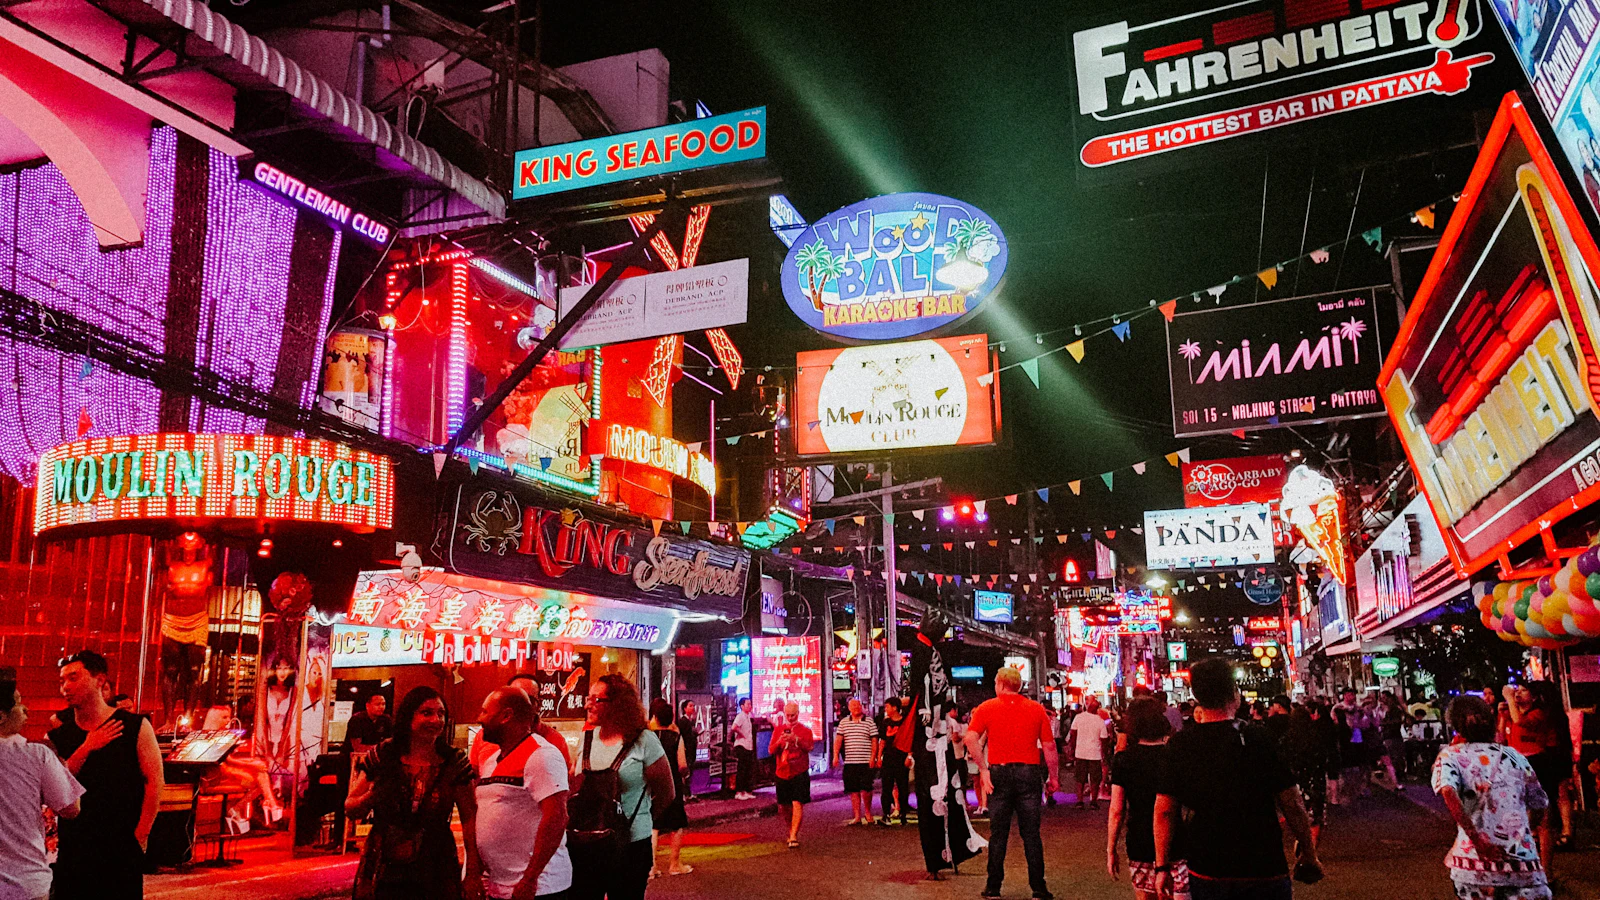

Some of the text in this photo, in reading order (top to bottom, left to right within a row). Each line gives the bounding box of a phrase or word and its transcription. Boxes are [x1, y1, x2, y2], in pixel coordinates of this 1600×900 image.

[1073, 1, 1429, 115] FAHRENHEIT
[1108, 71, 1442, 156] THE HOTTEST BAR IN PATTAYA
[519, 120, 761, 187] KING SEAFOOD
[254, 162, 389, 243] GENTLEMAN CLUB
[836, 254, 958, 300] BALL
[823, 294, 967, 328] KARAOKE BAR
[826, 407, 893, 427] MULIN
[1183, 411, 1198, 424] SOI
[1204, 408, 1217, 422] 15
[1232, 401, 1275, 420] WALKING
[1280, 396, 1315, 413] STREET
[1331, 389, 1376, 408] PATTAYA
[52, 449, 375, 506] MOULIN ROUGE
[1211, 479, 1260, 491] AGO-GO
[1212, 468, 1282, 483] SUGARBABY
[1157, 523, 1261, 546] PANDA
